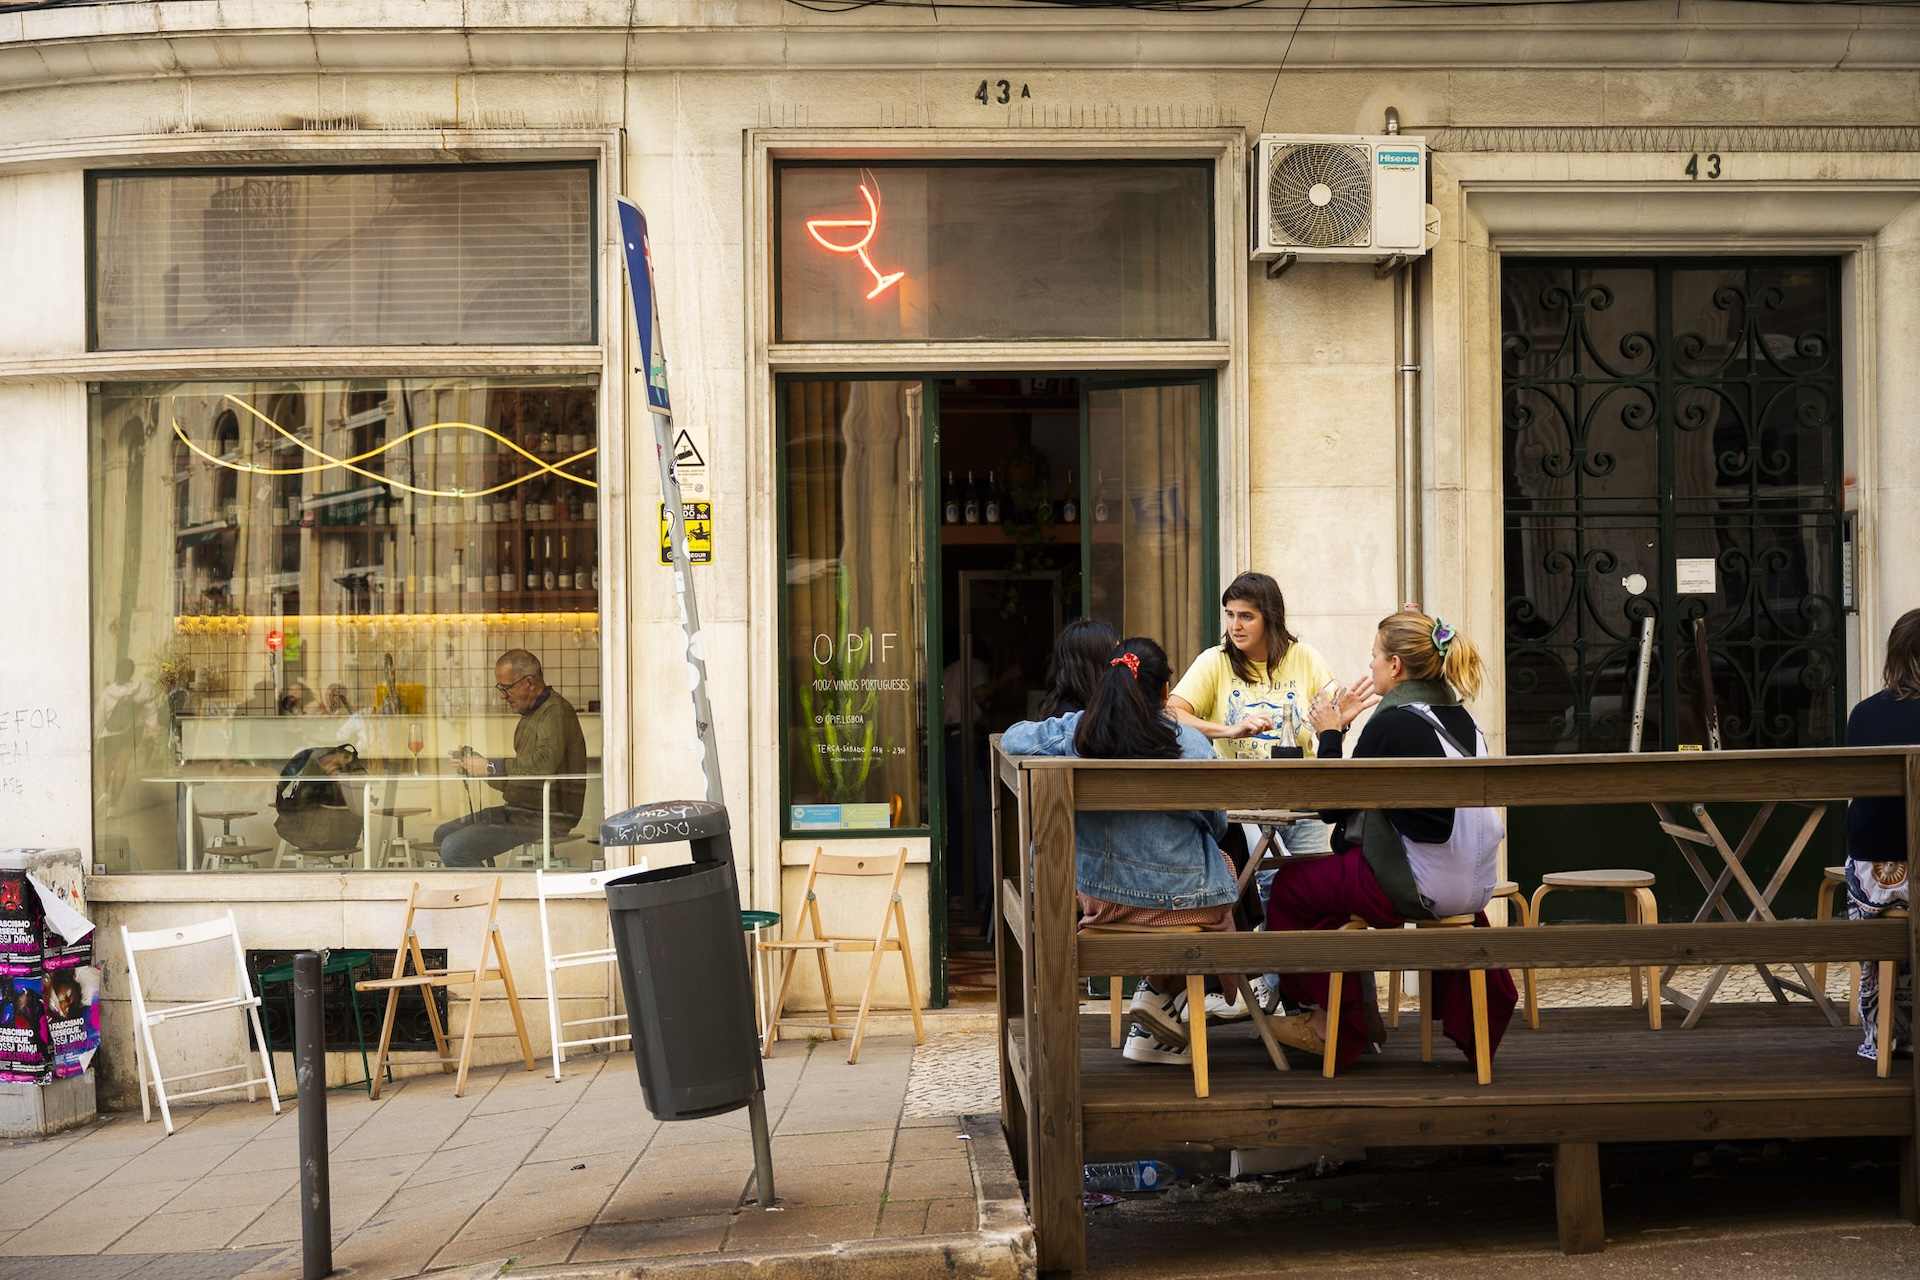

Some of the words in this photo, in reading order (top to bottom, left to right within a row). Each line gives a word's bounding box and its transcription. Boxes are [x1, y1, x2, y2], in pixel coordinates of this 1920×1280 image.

[1380, 154, 1418, 162] Hisense
[1685, 153, 1721, 180] 43
[813, 633, 833, 665] O
[847, 633, 897, 664] PIF
[833, 680, 859, 691] VINHOS
[861, 679, 910, 691] PORTUGUESES
[52, 1017, 84, 1031] FASCISMO
